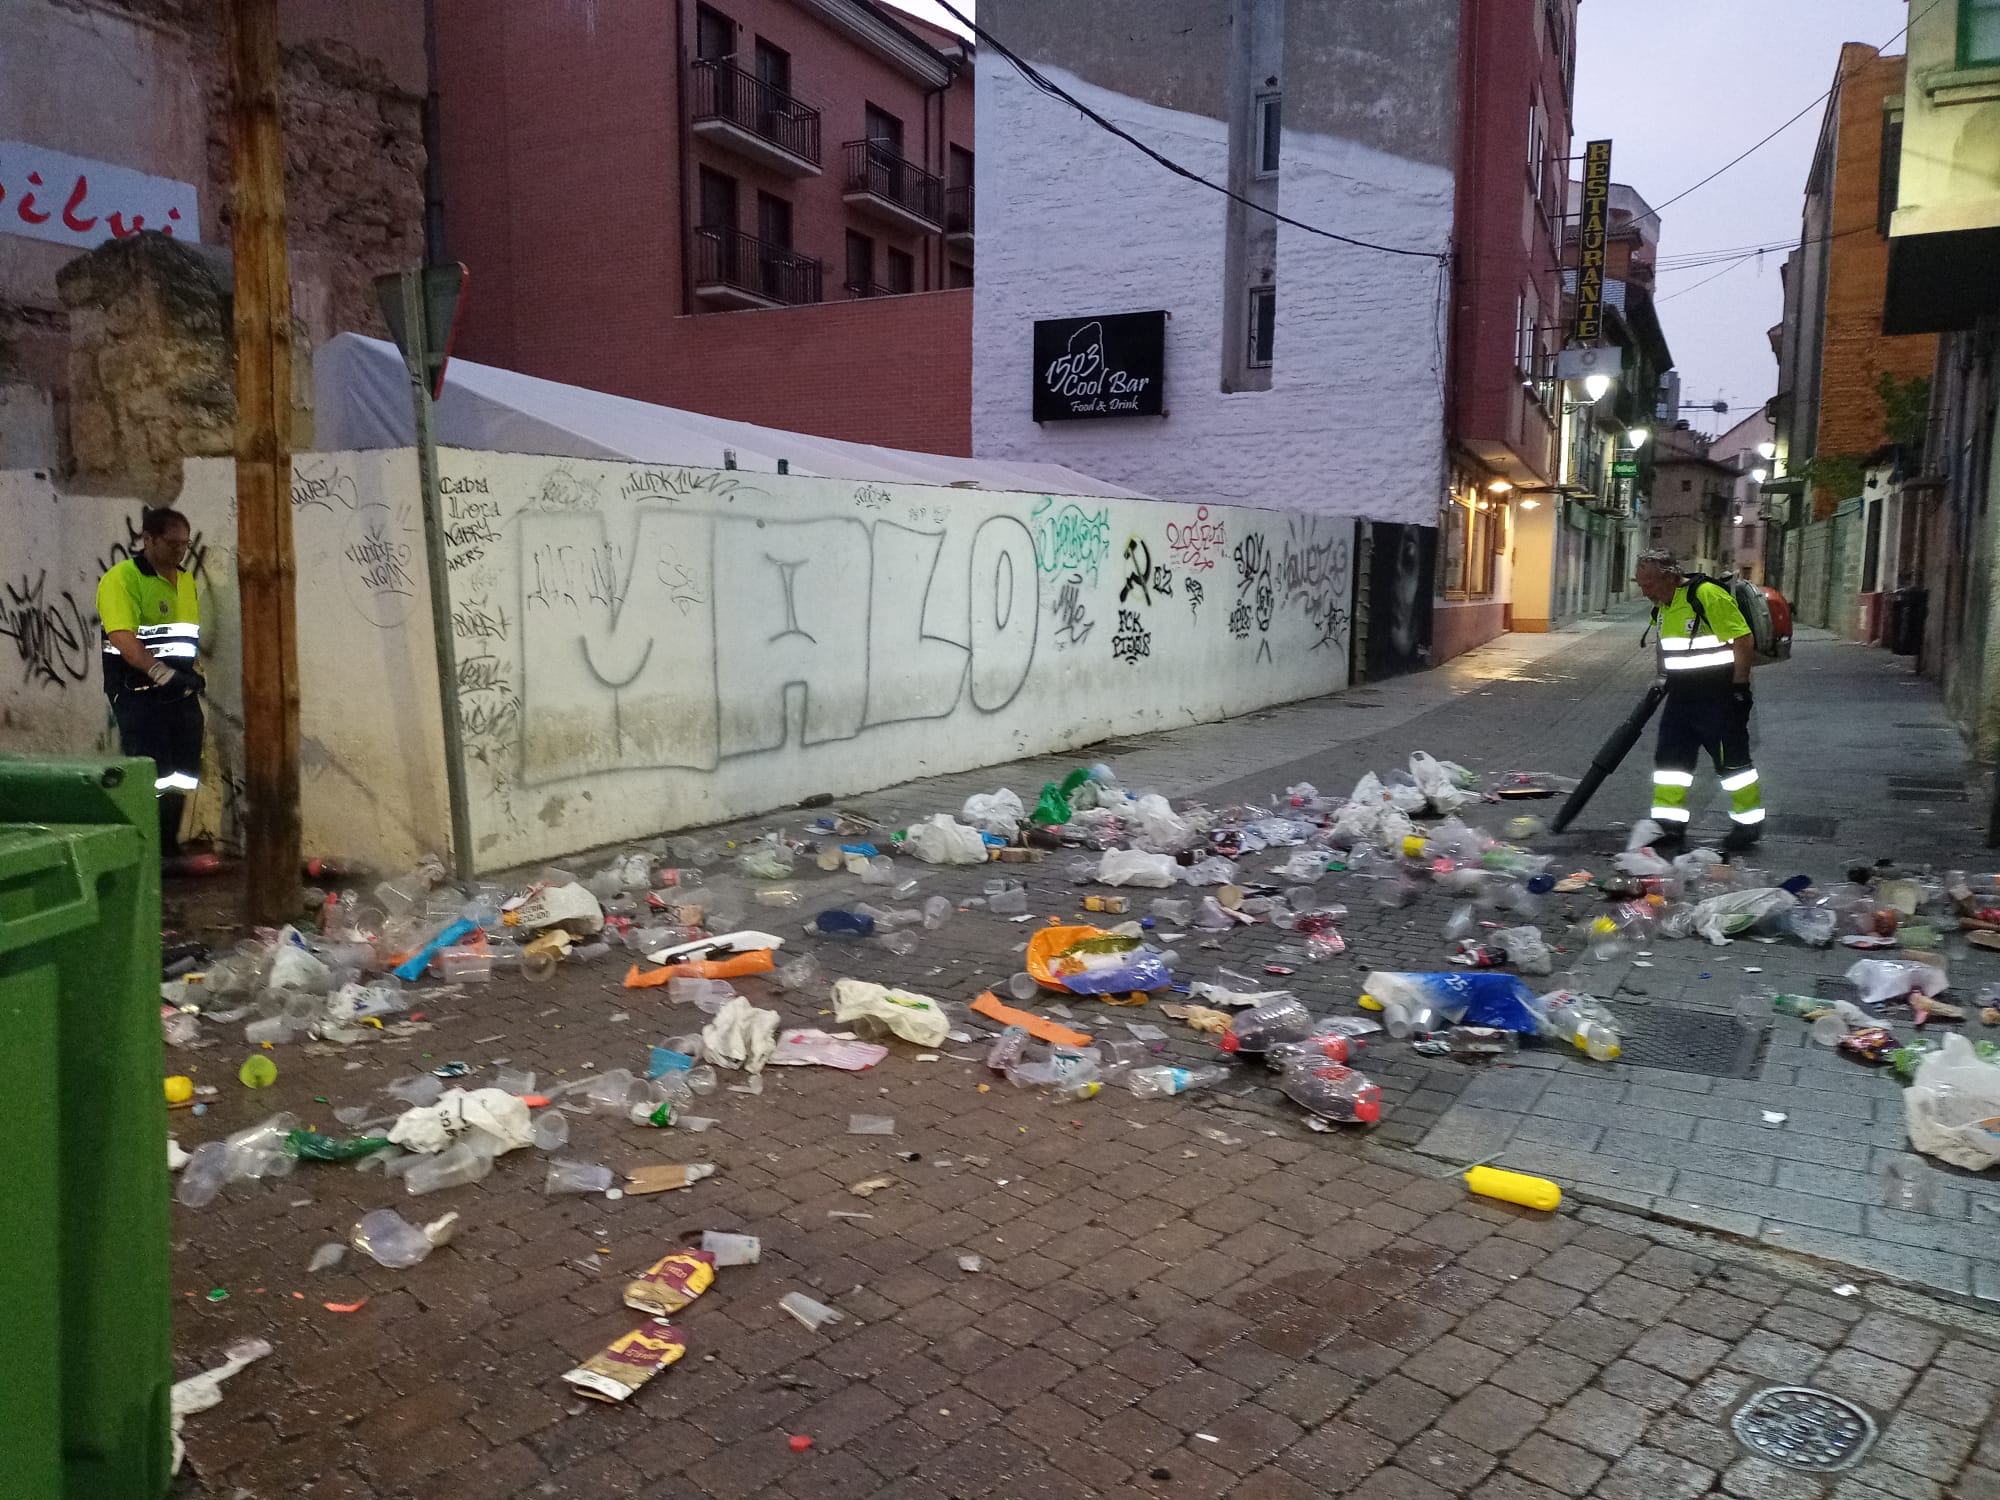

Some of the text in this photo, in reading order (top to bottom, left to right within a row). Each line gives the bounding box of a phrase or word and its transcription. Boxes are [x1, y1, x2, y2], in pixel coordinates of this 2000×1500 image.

[1578, 143, 1609, 337] RESTAURANTE
[1045, 343, 1100, 392] 1503
[1063, 368, 1149, 396] Cool Bar
[1070, 395, 1139, 412] Food & Drink
[1118, 609, 1144, 633] FCK
